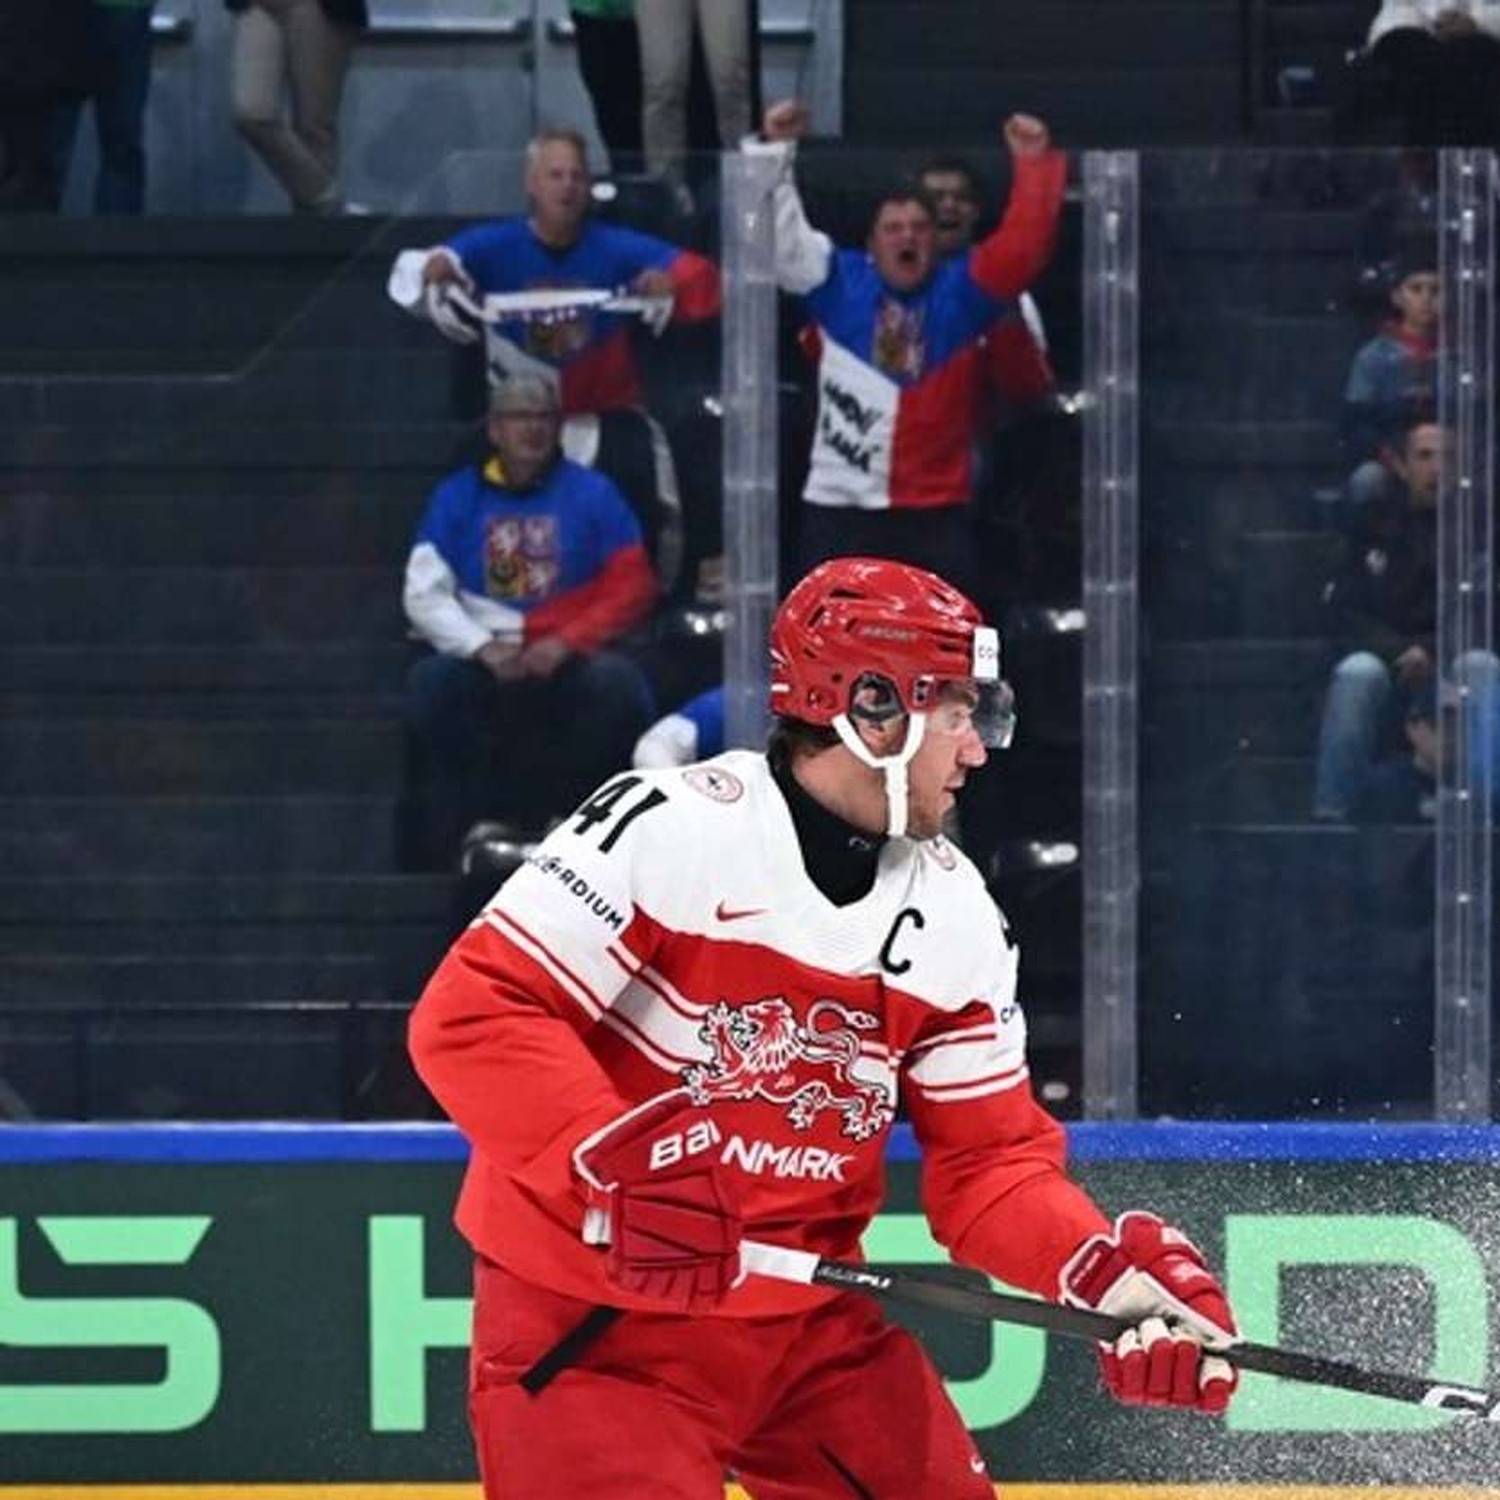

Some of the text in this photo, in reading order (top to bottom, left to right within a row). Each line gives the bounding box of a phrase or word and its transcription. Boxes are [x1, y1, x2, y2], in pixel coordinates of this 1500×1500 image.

[573, 776, 668, 854] 41
[878, 907, 926, 976] C
[720, 1135, 855, 1182] NMARK
